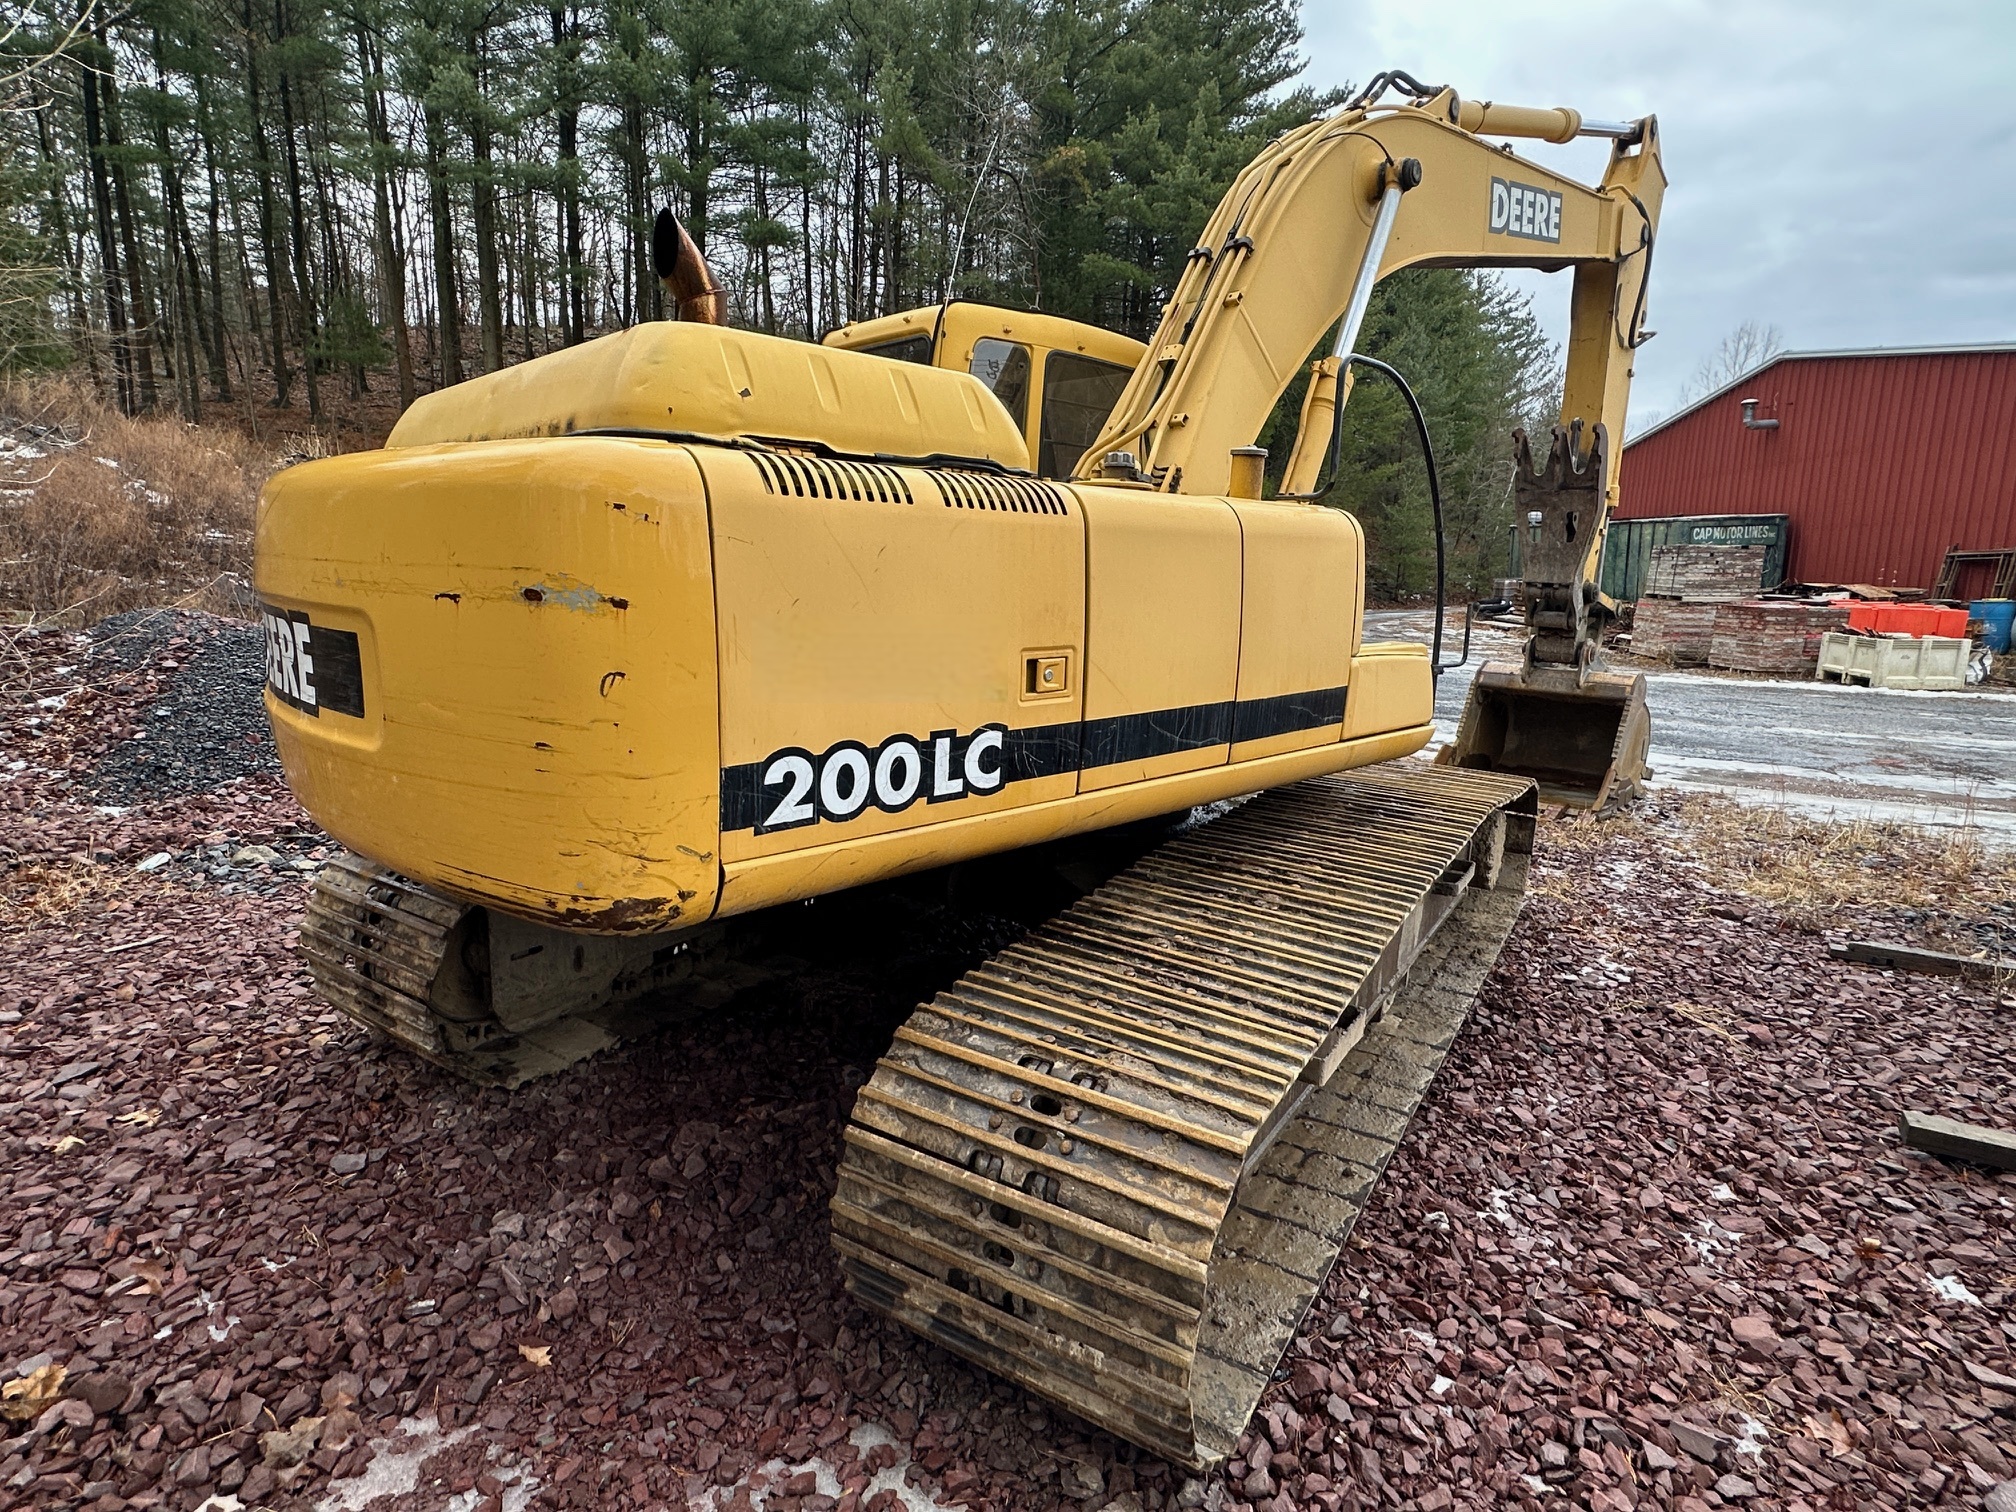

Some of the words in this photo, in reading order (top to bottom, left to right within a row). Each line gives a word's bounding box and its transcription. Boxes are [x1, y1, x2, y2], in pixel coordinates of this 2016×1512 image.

[1491, 182, 1561, 239] DEERE
[1693, 527, 1713, 540] CAP
[1713, 526, 1744, 540] MOTOR
[1744, 525, 1769, 539] LINES
